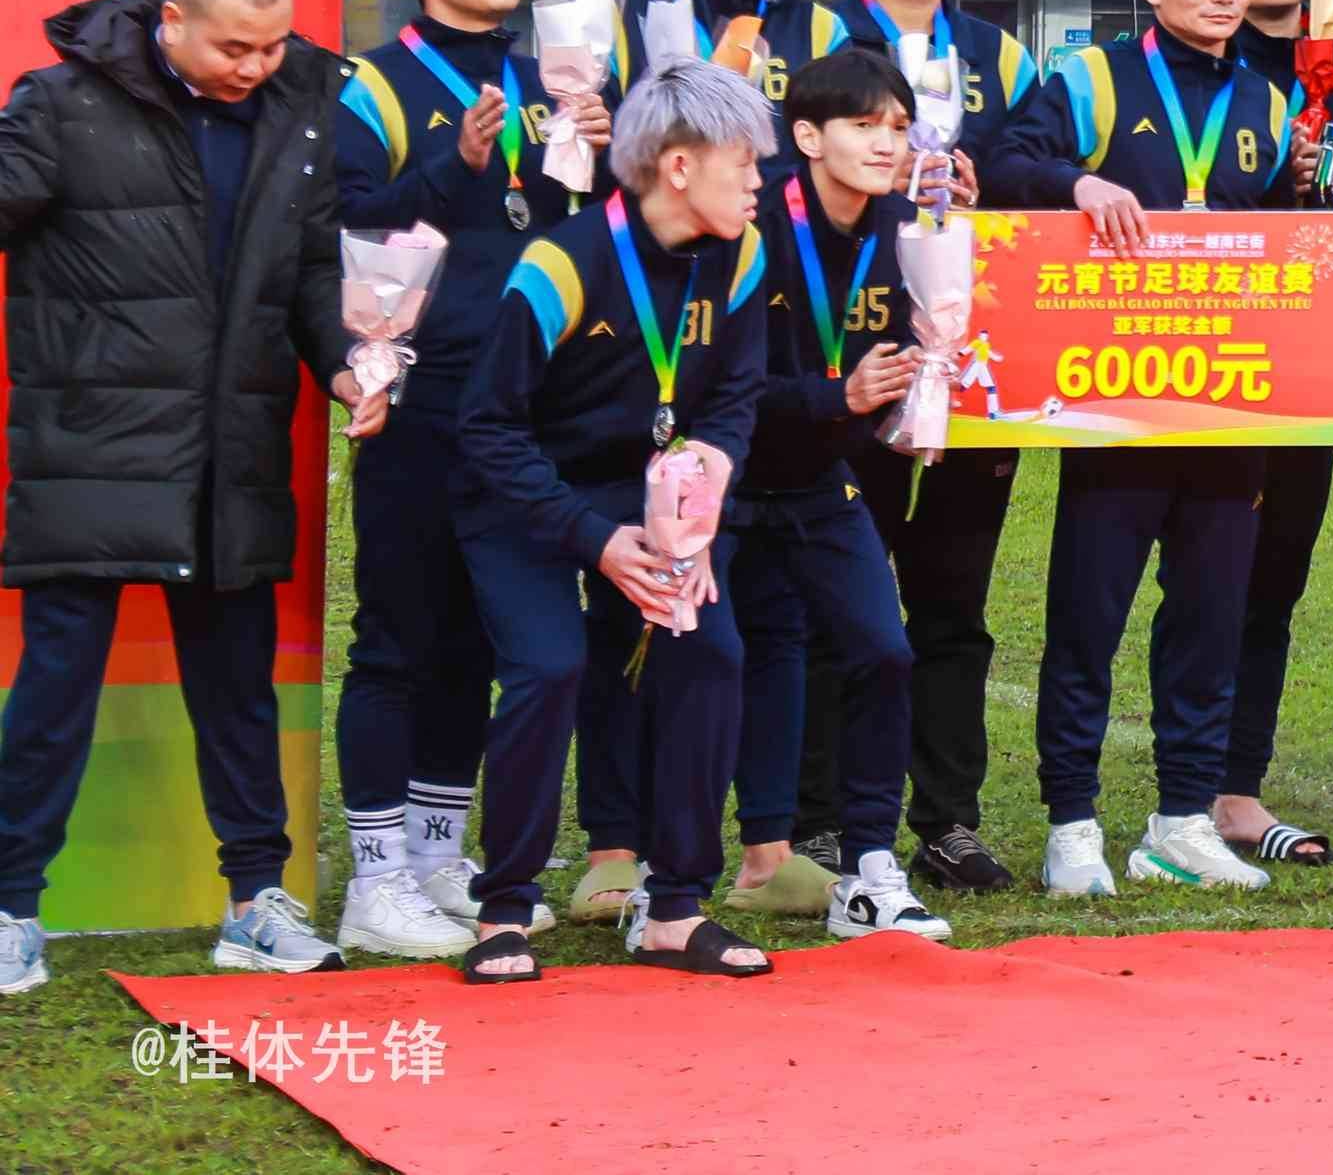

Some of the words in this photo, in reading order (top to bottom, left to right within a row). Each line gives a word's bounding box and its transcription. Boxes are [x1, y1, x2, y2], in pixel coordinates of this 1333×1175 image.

[1236, 128, 1257, 173] 8
[1036, 262, 1315, 295] 元宵节足球友谊赛
[1112, 315, 1233, 336] 亚军获奖金额
[1055, 341, 1272, 403] 6000元
